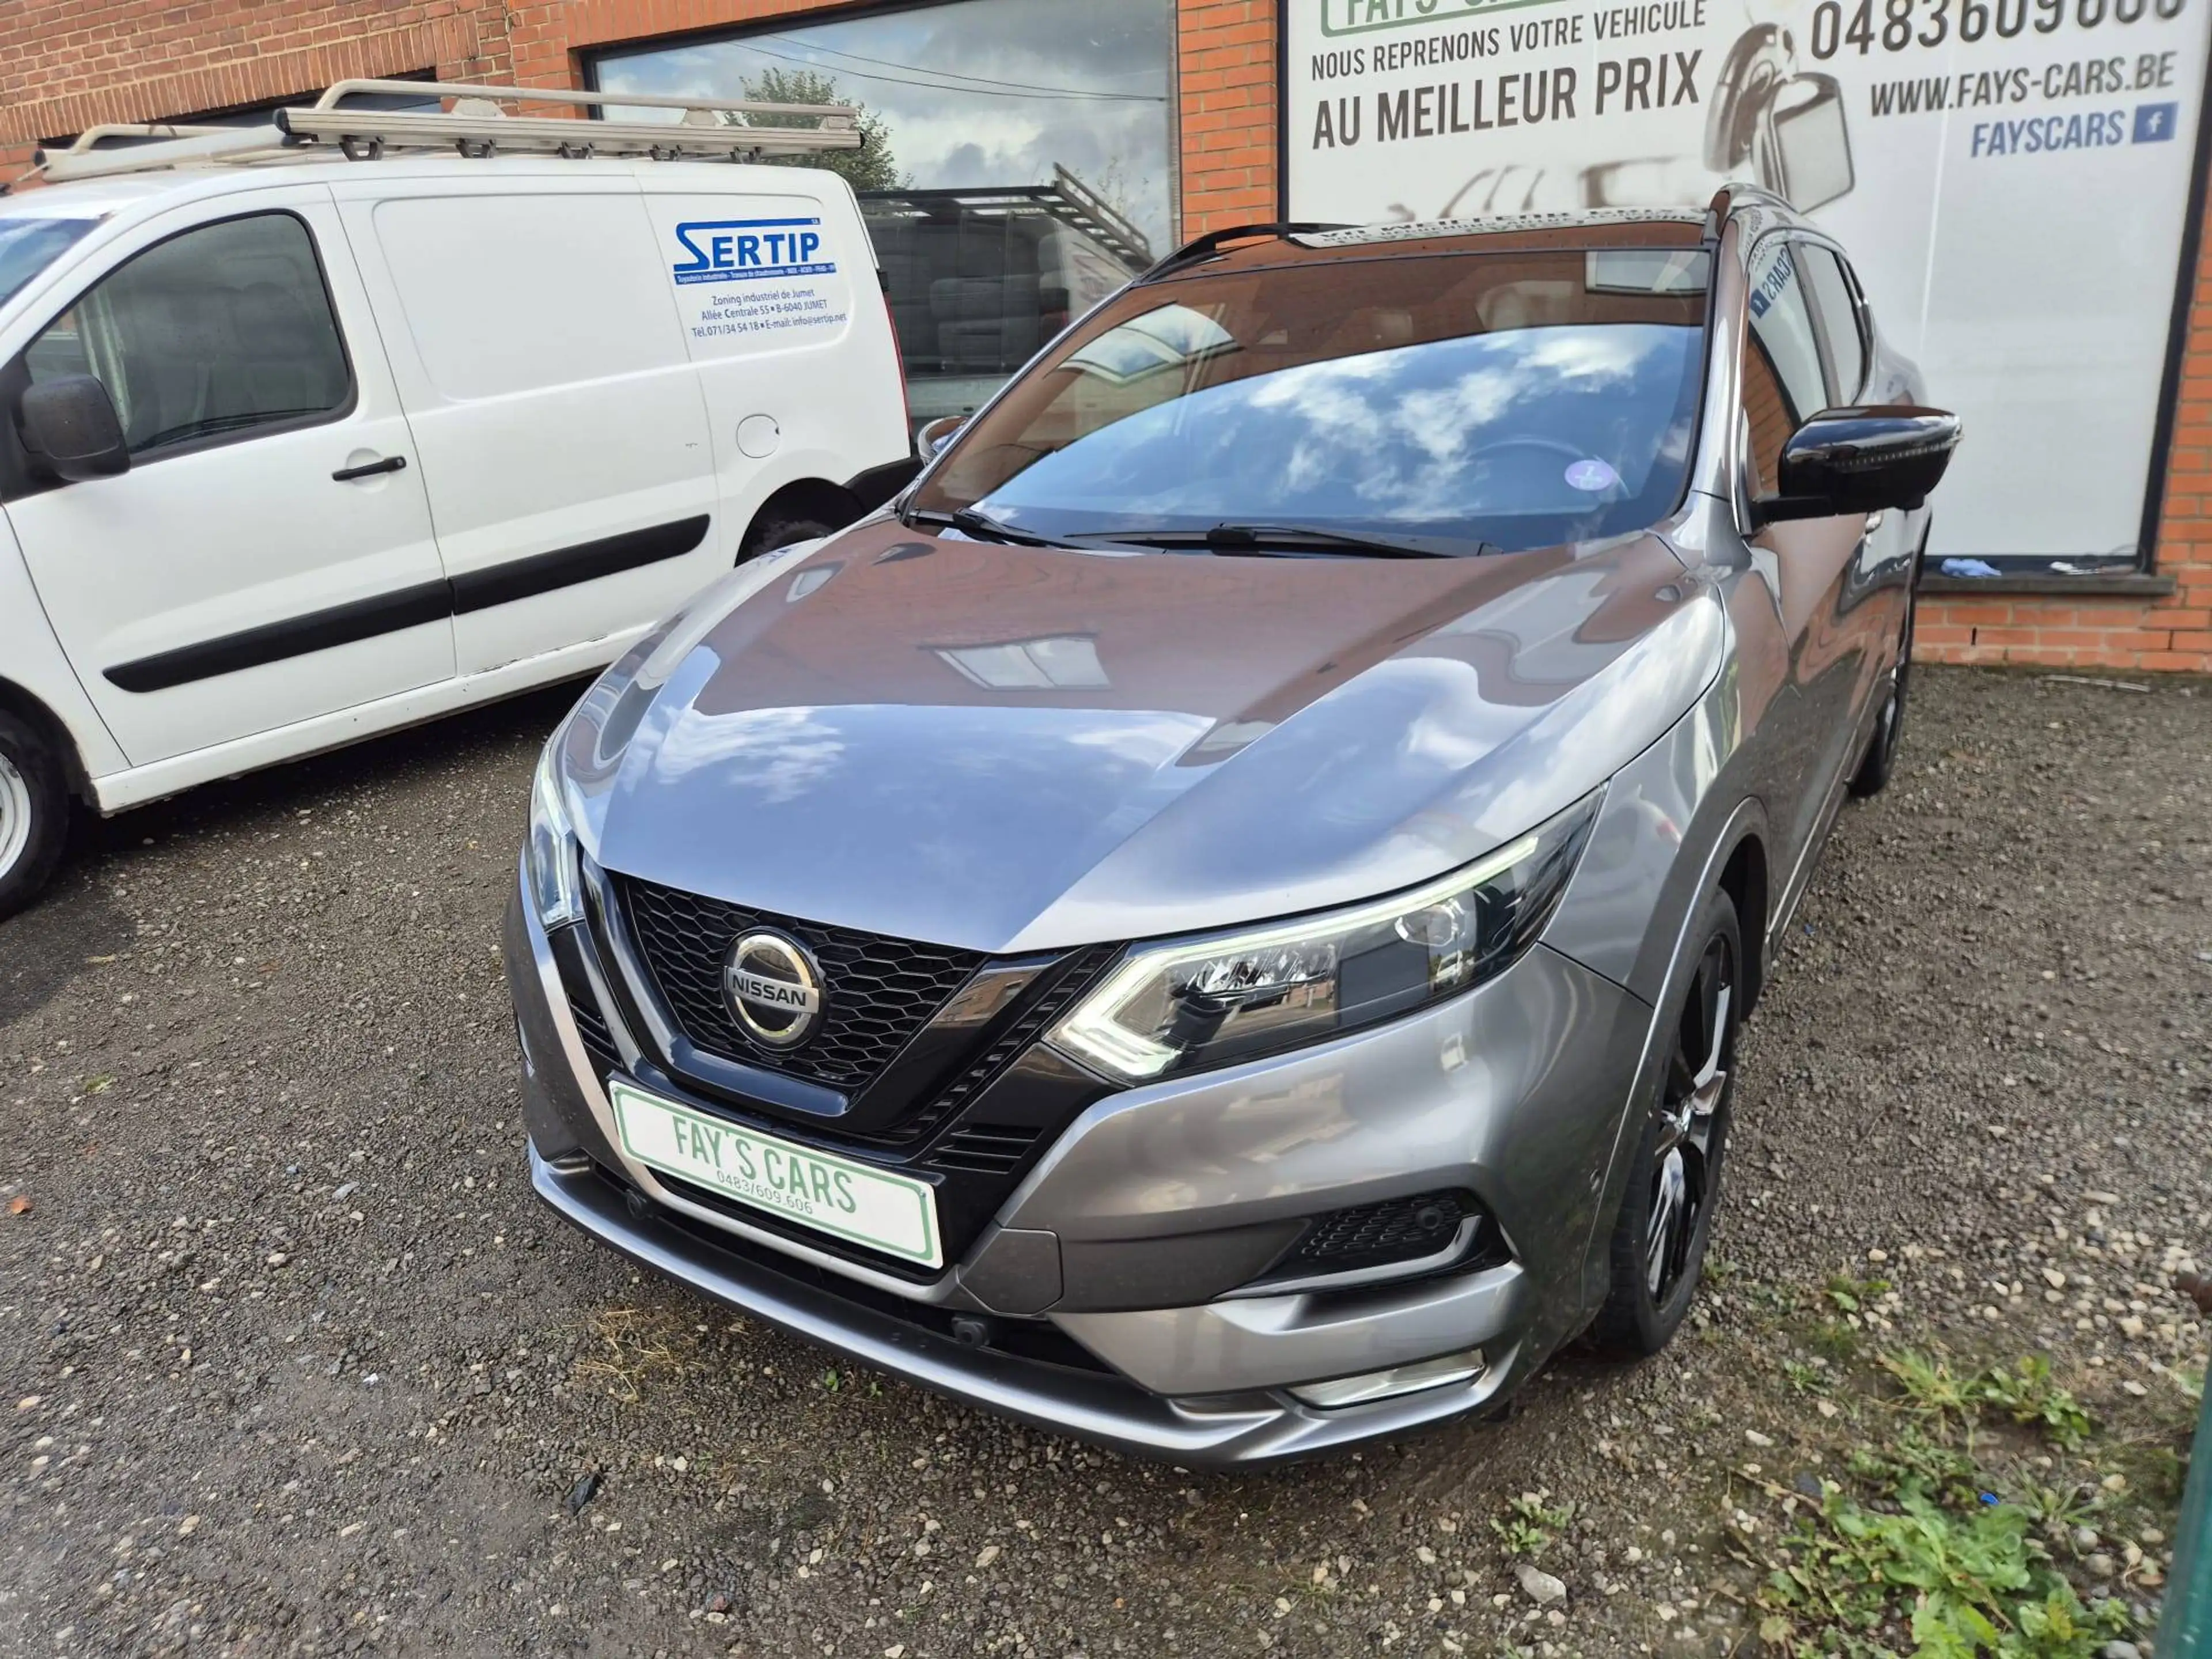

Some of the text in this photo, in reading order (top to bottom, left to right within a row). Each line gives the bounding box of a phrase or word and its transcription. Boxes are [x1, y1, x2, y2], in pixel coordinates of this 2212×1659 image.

[1312, 0, 1706, 81] NOUS REPRENONS VOTRE VEHICULE
[1312, 50, 1703, 150] AU MEILLEUR PRIX
[1872, 51, 2178, 118] WWW.FAYS-CARS.BE
[1970, 109, 2126, 158] FAYSCARS
[673, 217, 821, 272] SERTIP
[711, 288, 815, 306] Zoning industriel de Jumet
[725, 305, 759, 319] Centrale
[760, 304, 770, 315] 55
[804, 298, 828, 311] JUMET
[733, 974, 806, 1006] NISSAN
[763, 1148, 857, 1214] CARS
